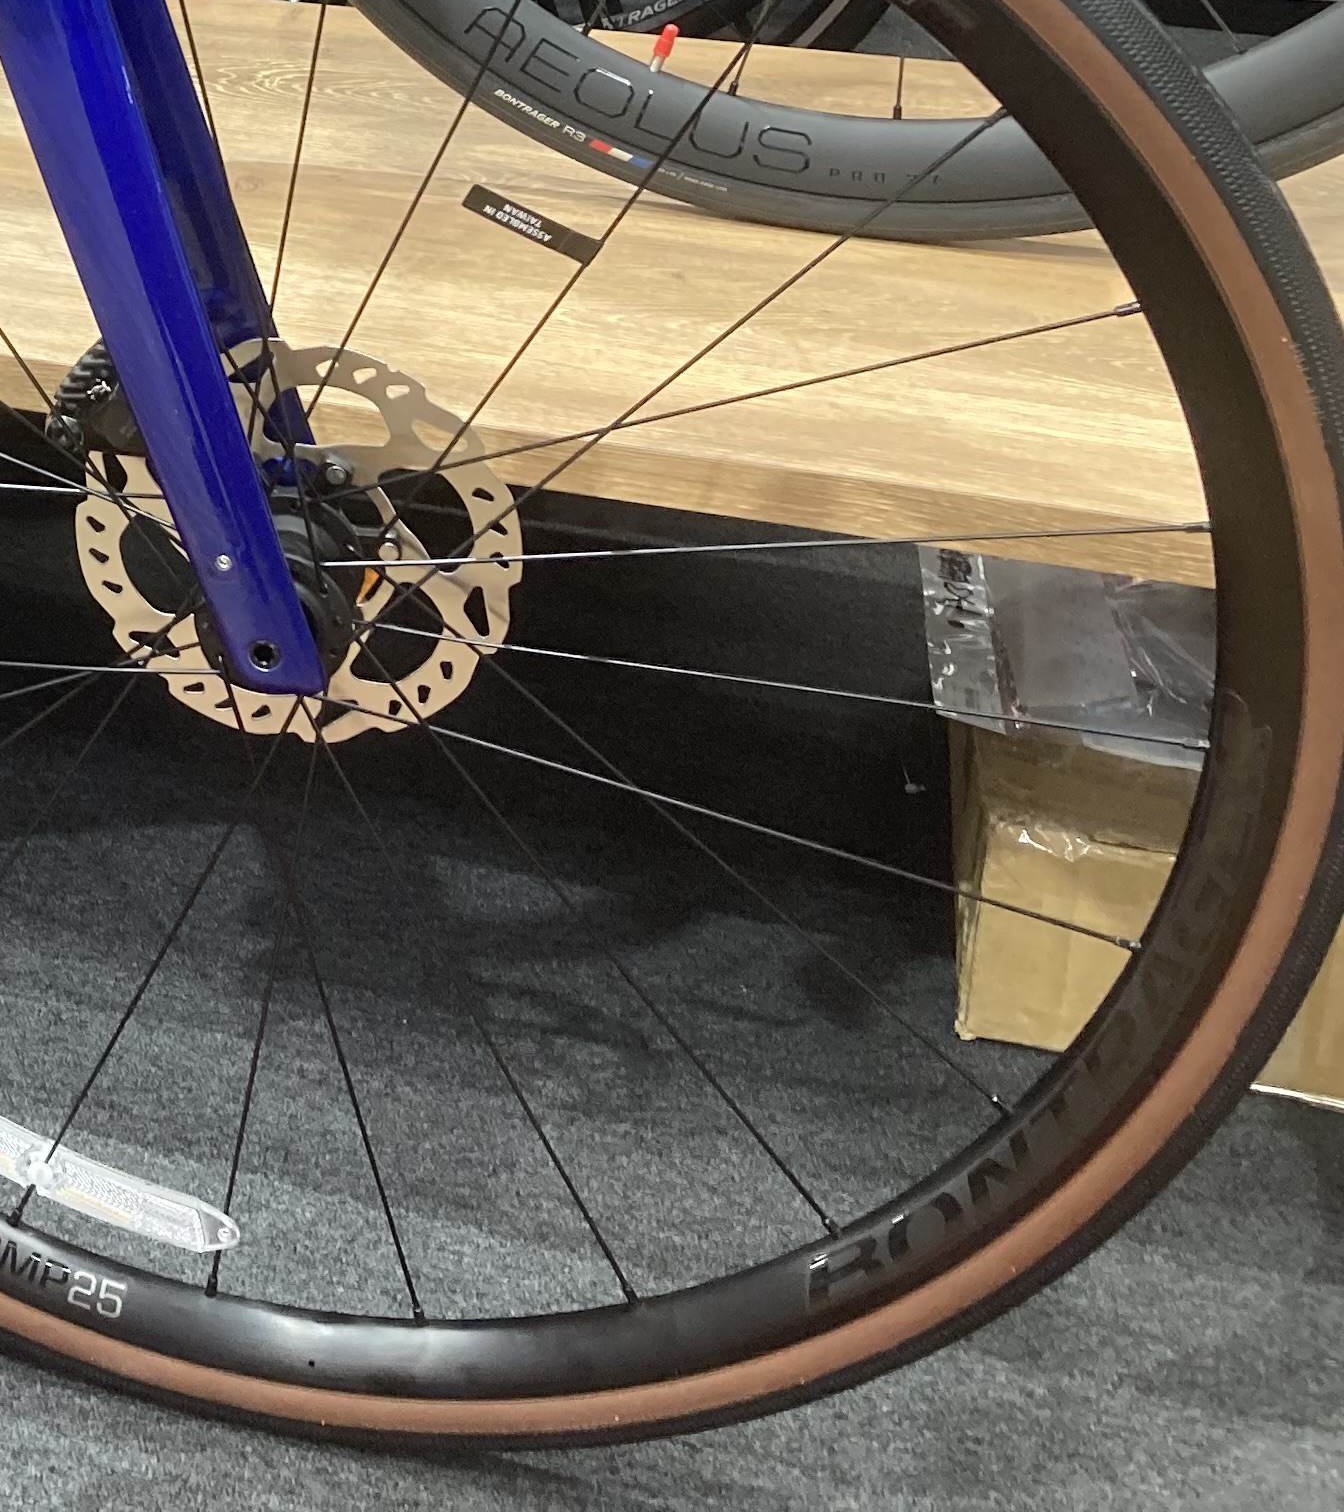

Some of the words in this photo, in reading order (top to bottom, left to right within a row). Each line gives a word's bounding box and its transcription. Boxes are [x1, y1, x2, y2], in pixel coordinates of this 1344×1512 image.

[464, 6, 812, 174] AEOLUS
[493, 89, 561, 129] BONTRAGER
[563, 125, 587, 143] R3
